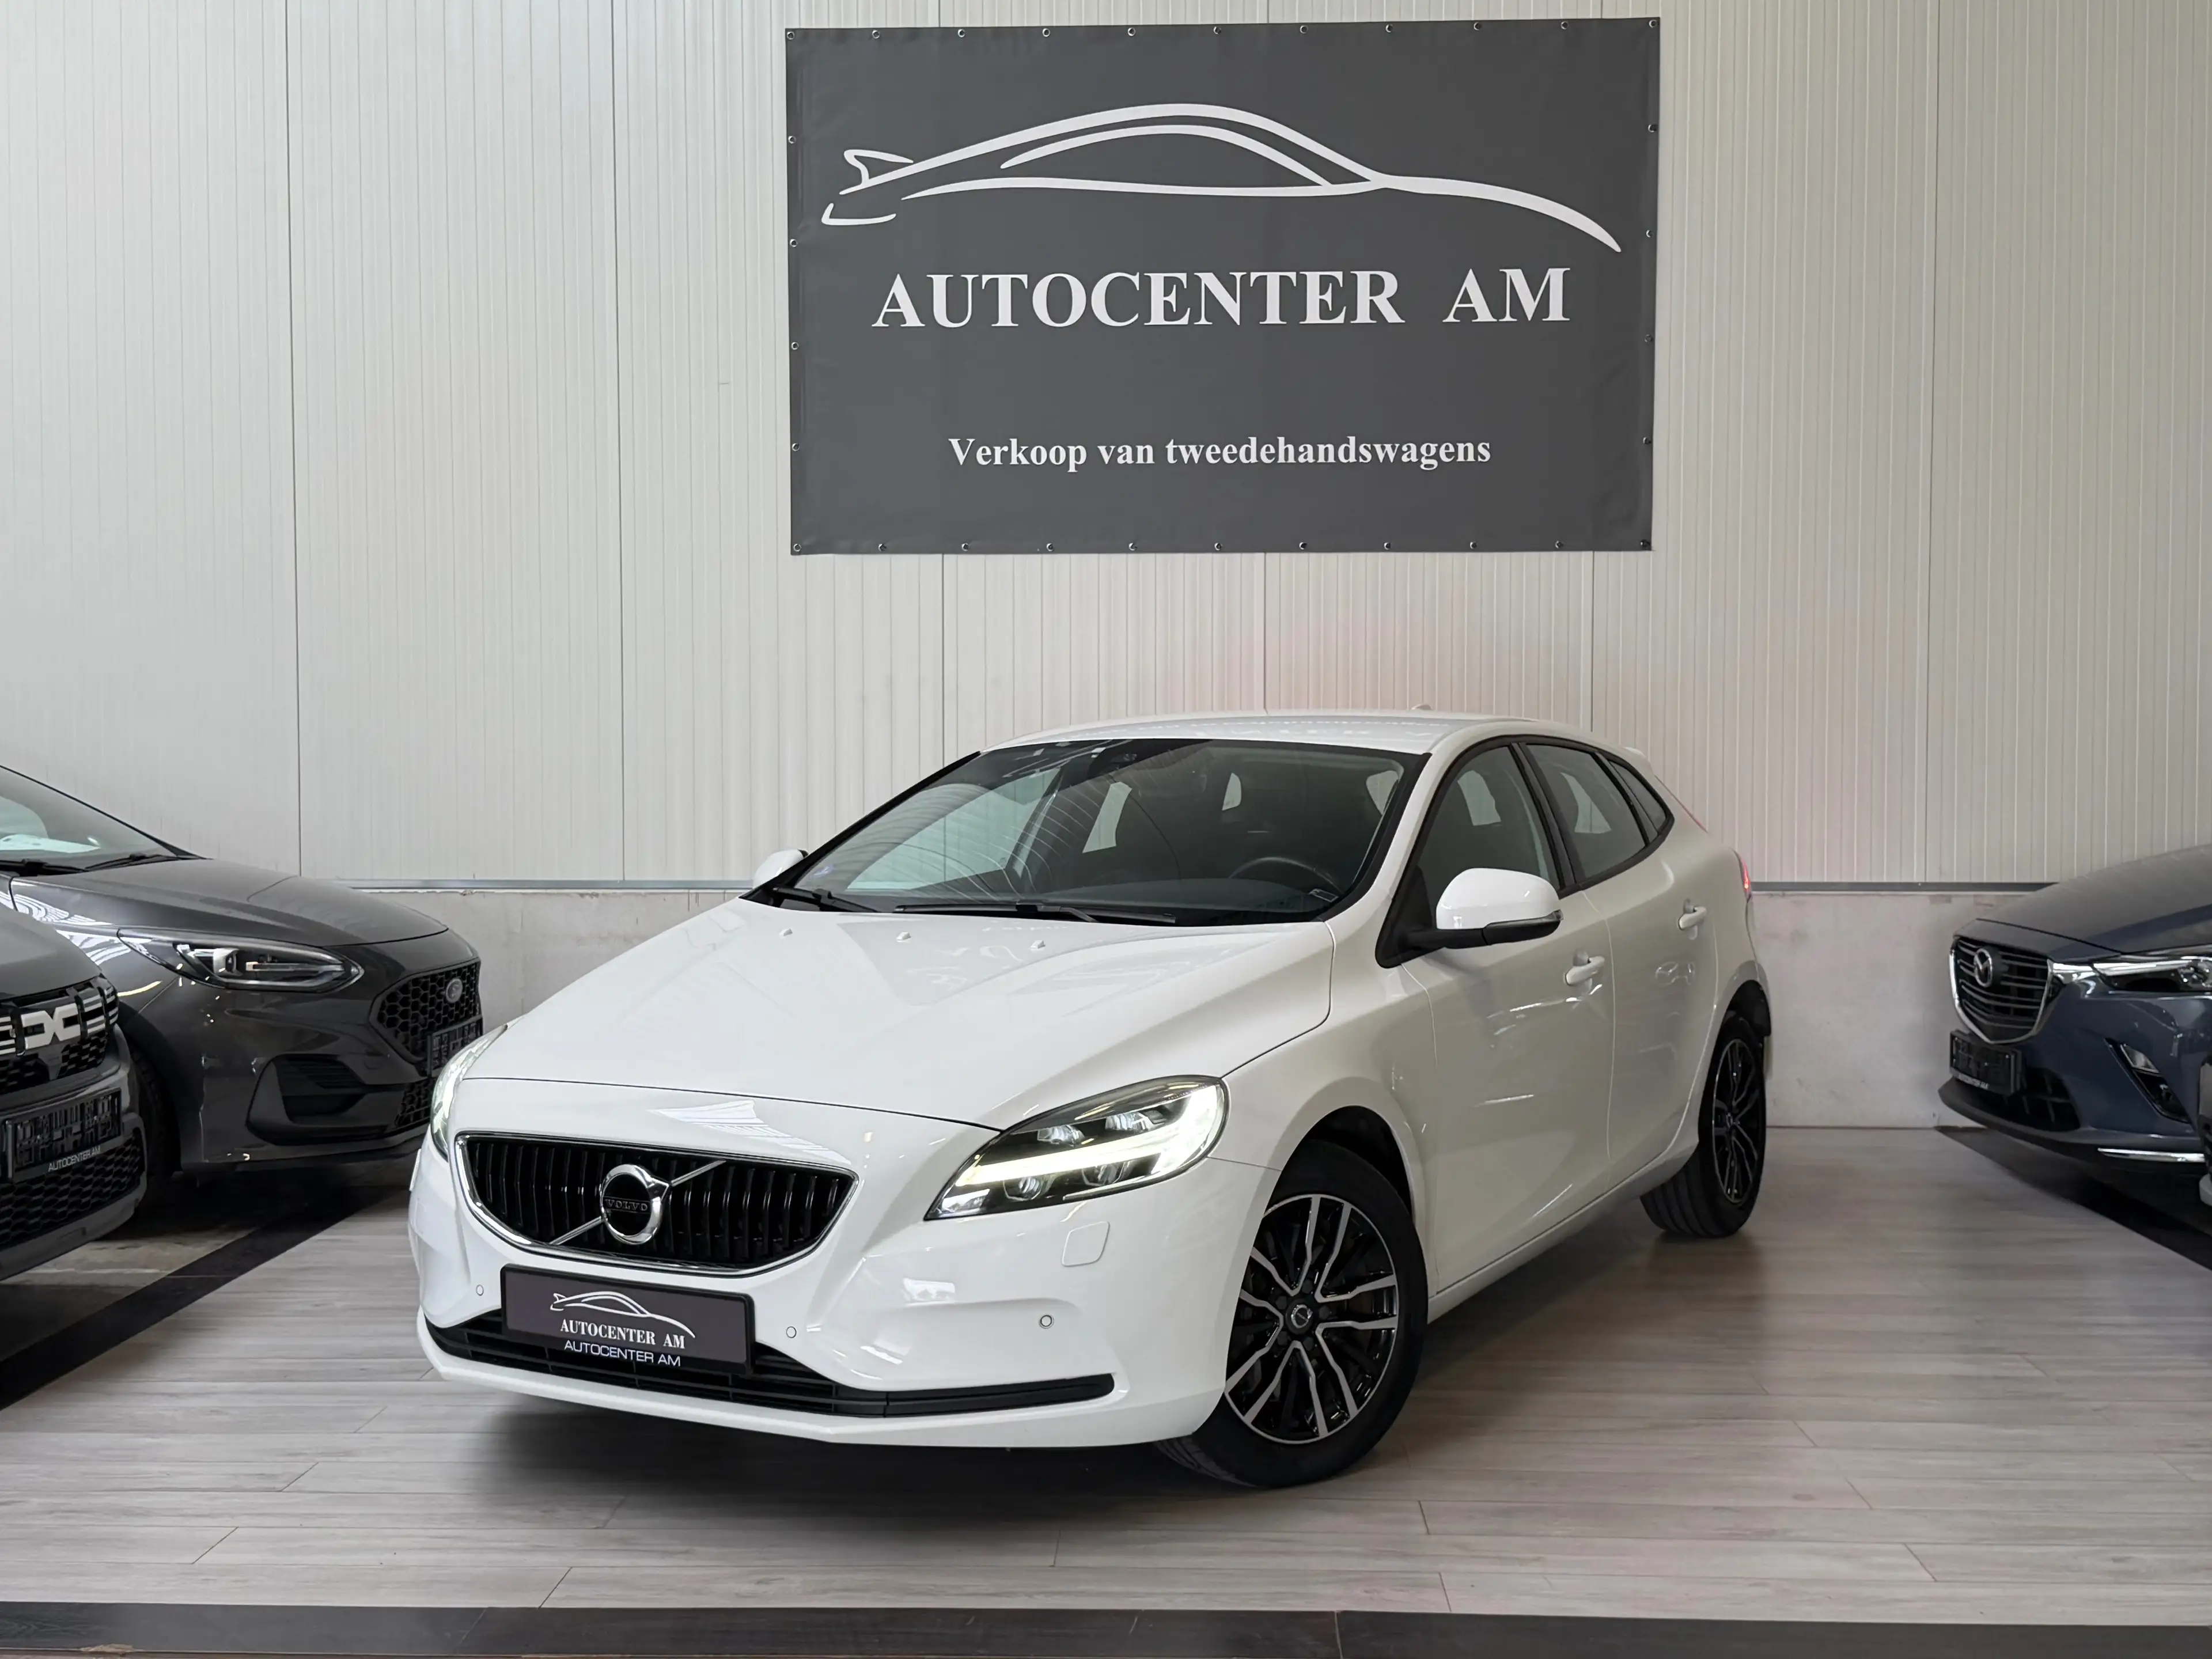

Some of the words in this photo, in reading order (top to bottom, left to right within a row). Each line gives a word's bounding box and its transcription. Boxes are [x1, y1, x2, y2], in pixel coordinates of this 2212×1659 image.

[871, 270, 1406, 328] AUTOCENTER
[1441, 267, 1571, 323] AM
[948, 437, 1088, 474] Verkoop
[1096, 444, 1155, 465] van
[1165, 435, 1491, 471] tweedehandswagens
[48, 1149, 91, 1172] AUTOCENTER
[604, 1199, 648, 1211] VOLVO
[560, 1319, 656, 1345] AUTOCENTER
[663, 1334, 685, 1349] AM
[564, 1340, 654, 1363] AUTOCENTER
[658, 1354, 681, 1367] AM
